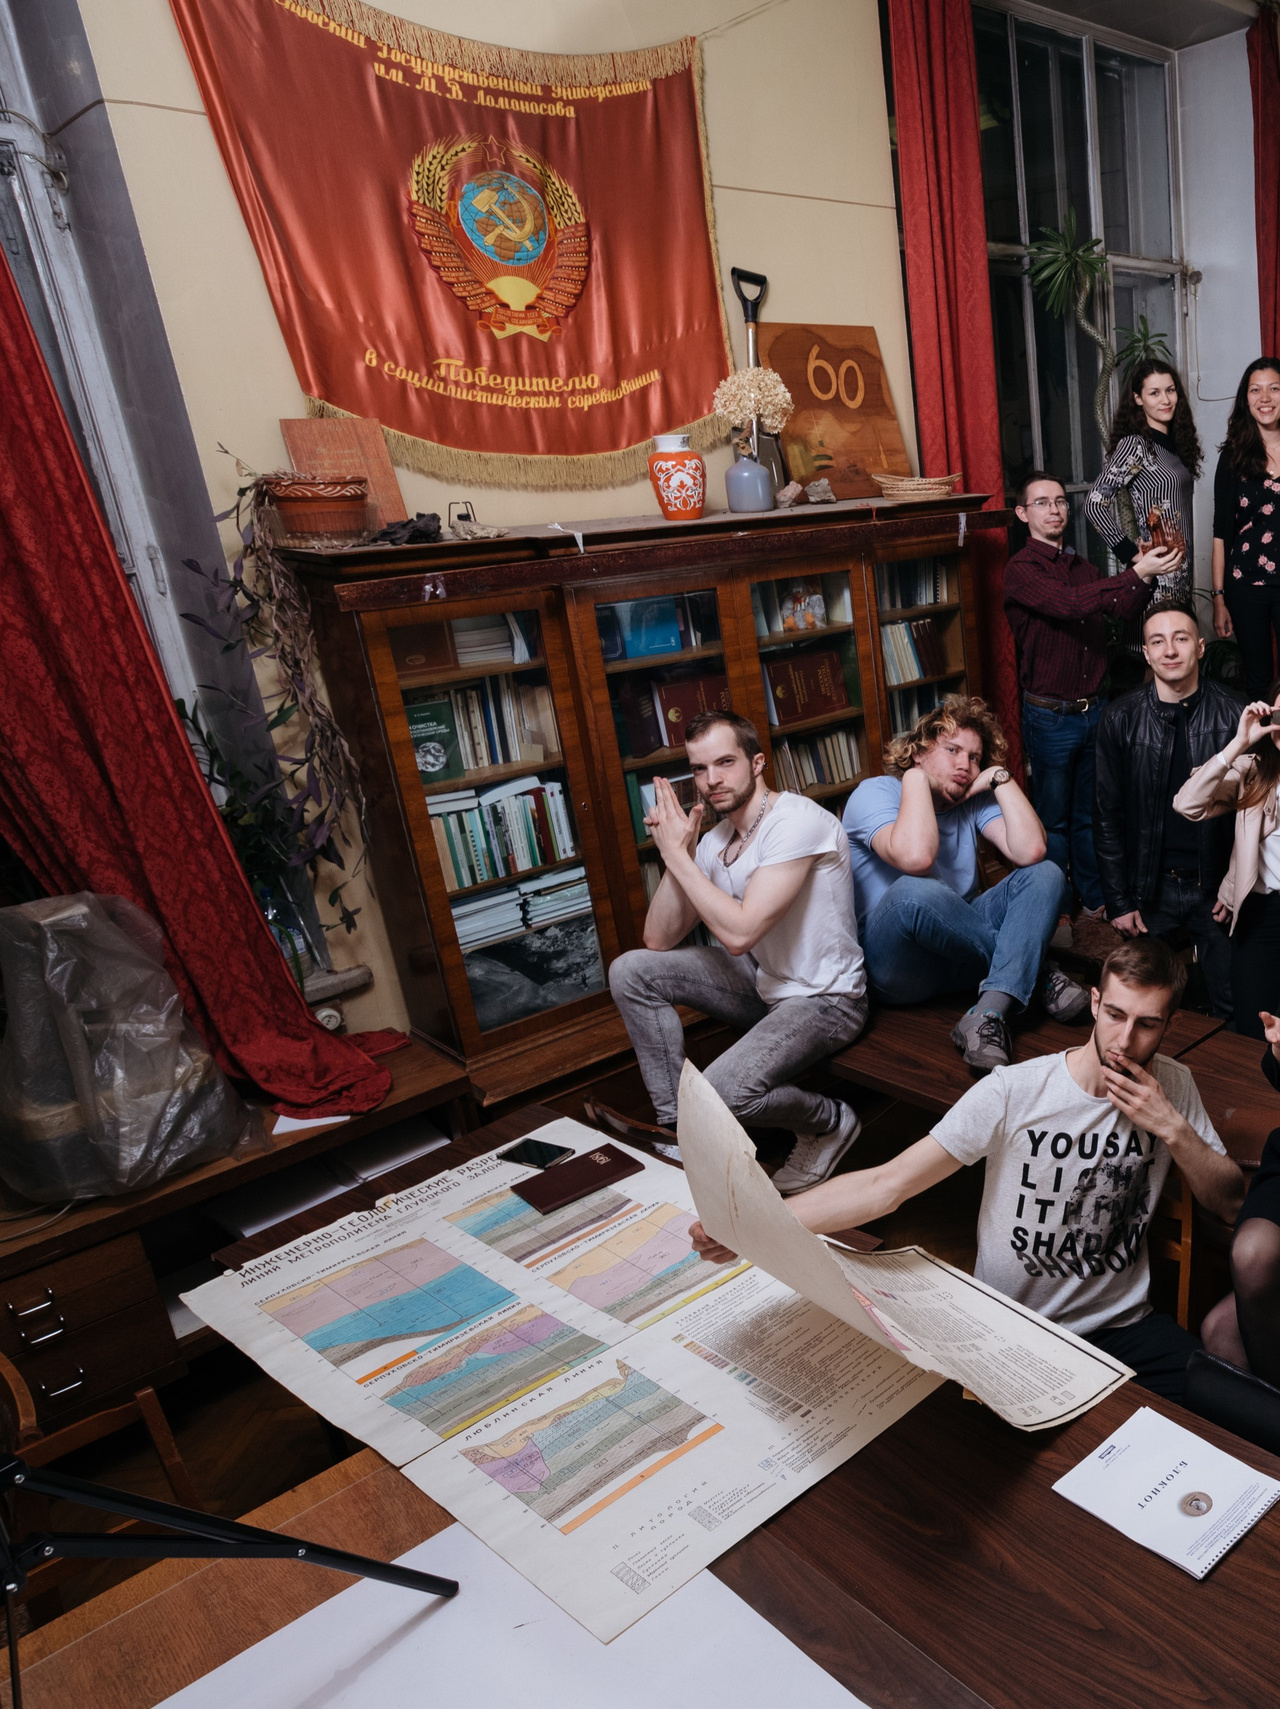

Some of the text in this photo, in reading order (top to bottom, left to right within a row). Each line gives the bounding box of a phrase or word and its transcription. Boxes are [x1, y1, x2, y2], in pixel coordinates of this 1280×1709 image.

[373, 62, 576, 118] им. М. В. Ломоносова
[365, 349, 661, 411] в социалистическом соревновании
[433, 358, 599, 396] Победителю
[806, 344, 865, 410] 60
[238, 1174, 450, 1279] ИНЖЕНЕРНО-ГЕОЛОГИЧЕСКИЕ
[458, 1150, 506, 1178] РАЗРЕ
[240, 1263, 281, 1288] ЛИНИЙ
[287, 1212, 392, 1266] МЕТРОПОЛИТЕНА
[395, 1178, 461, 1215] ГЛУБОКОГО
[496, 1300, 521, 1316] ЛИНИЯ
[463, 1357, 604, 1442] ЛЮБЛИНСКАЯ ЛИНИЯ
[780, 1414, 817, 1441] ПРОЧИЕ
[822, 1364, 882, 1411] ОБОЗНАЧЕНИЯ
[629, 1479, 708, 1537] ЛИТОЛОГИЯ
[649, 1499, 692, 1530] ПОРОД
[1135, 1458, 1189, 1511] БЛОКНОТ
